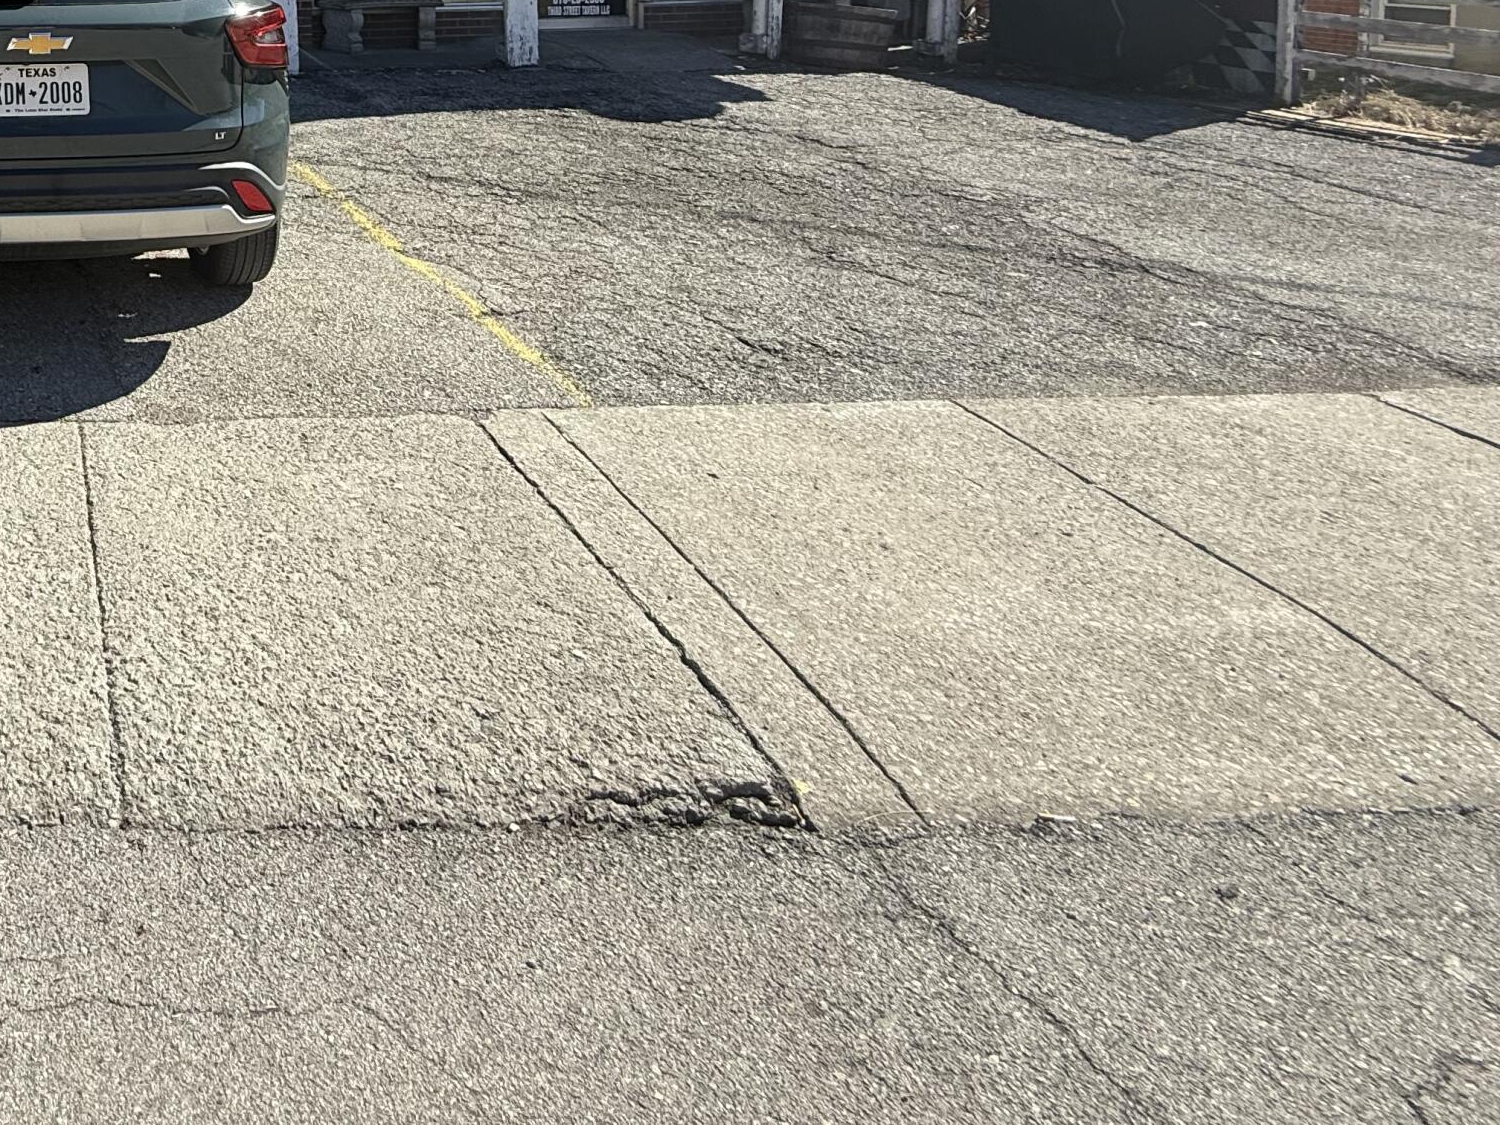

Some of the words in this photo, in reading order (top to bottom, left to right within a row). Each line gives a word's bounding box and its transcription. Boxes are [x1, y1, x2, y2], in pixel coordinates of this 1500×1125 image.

[18, 67, 57, 78] TEXAS
[39, 81, 83, 104] 2008
[215, 131, 227, 140] LT
